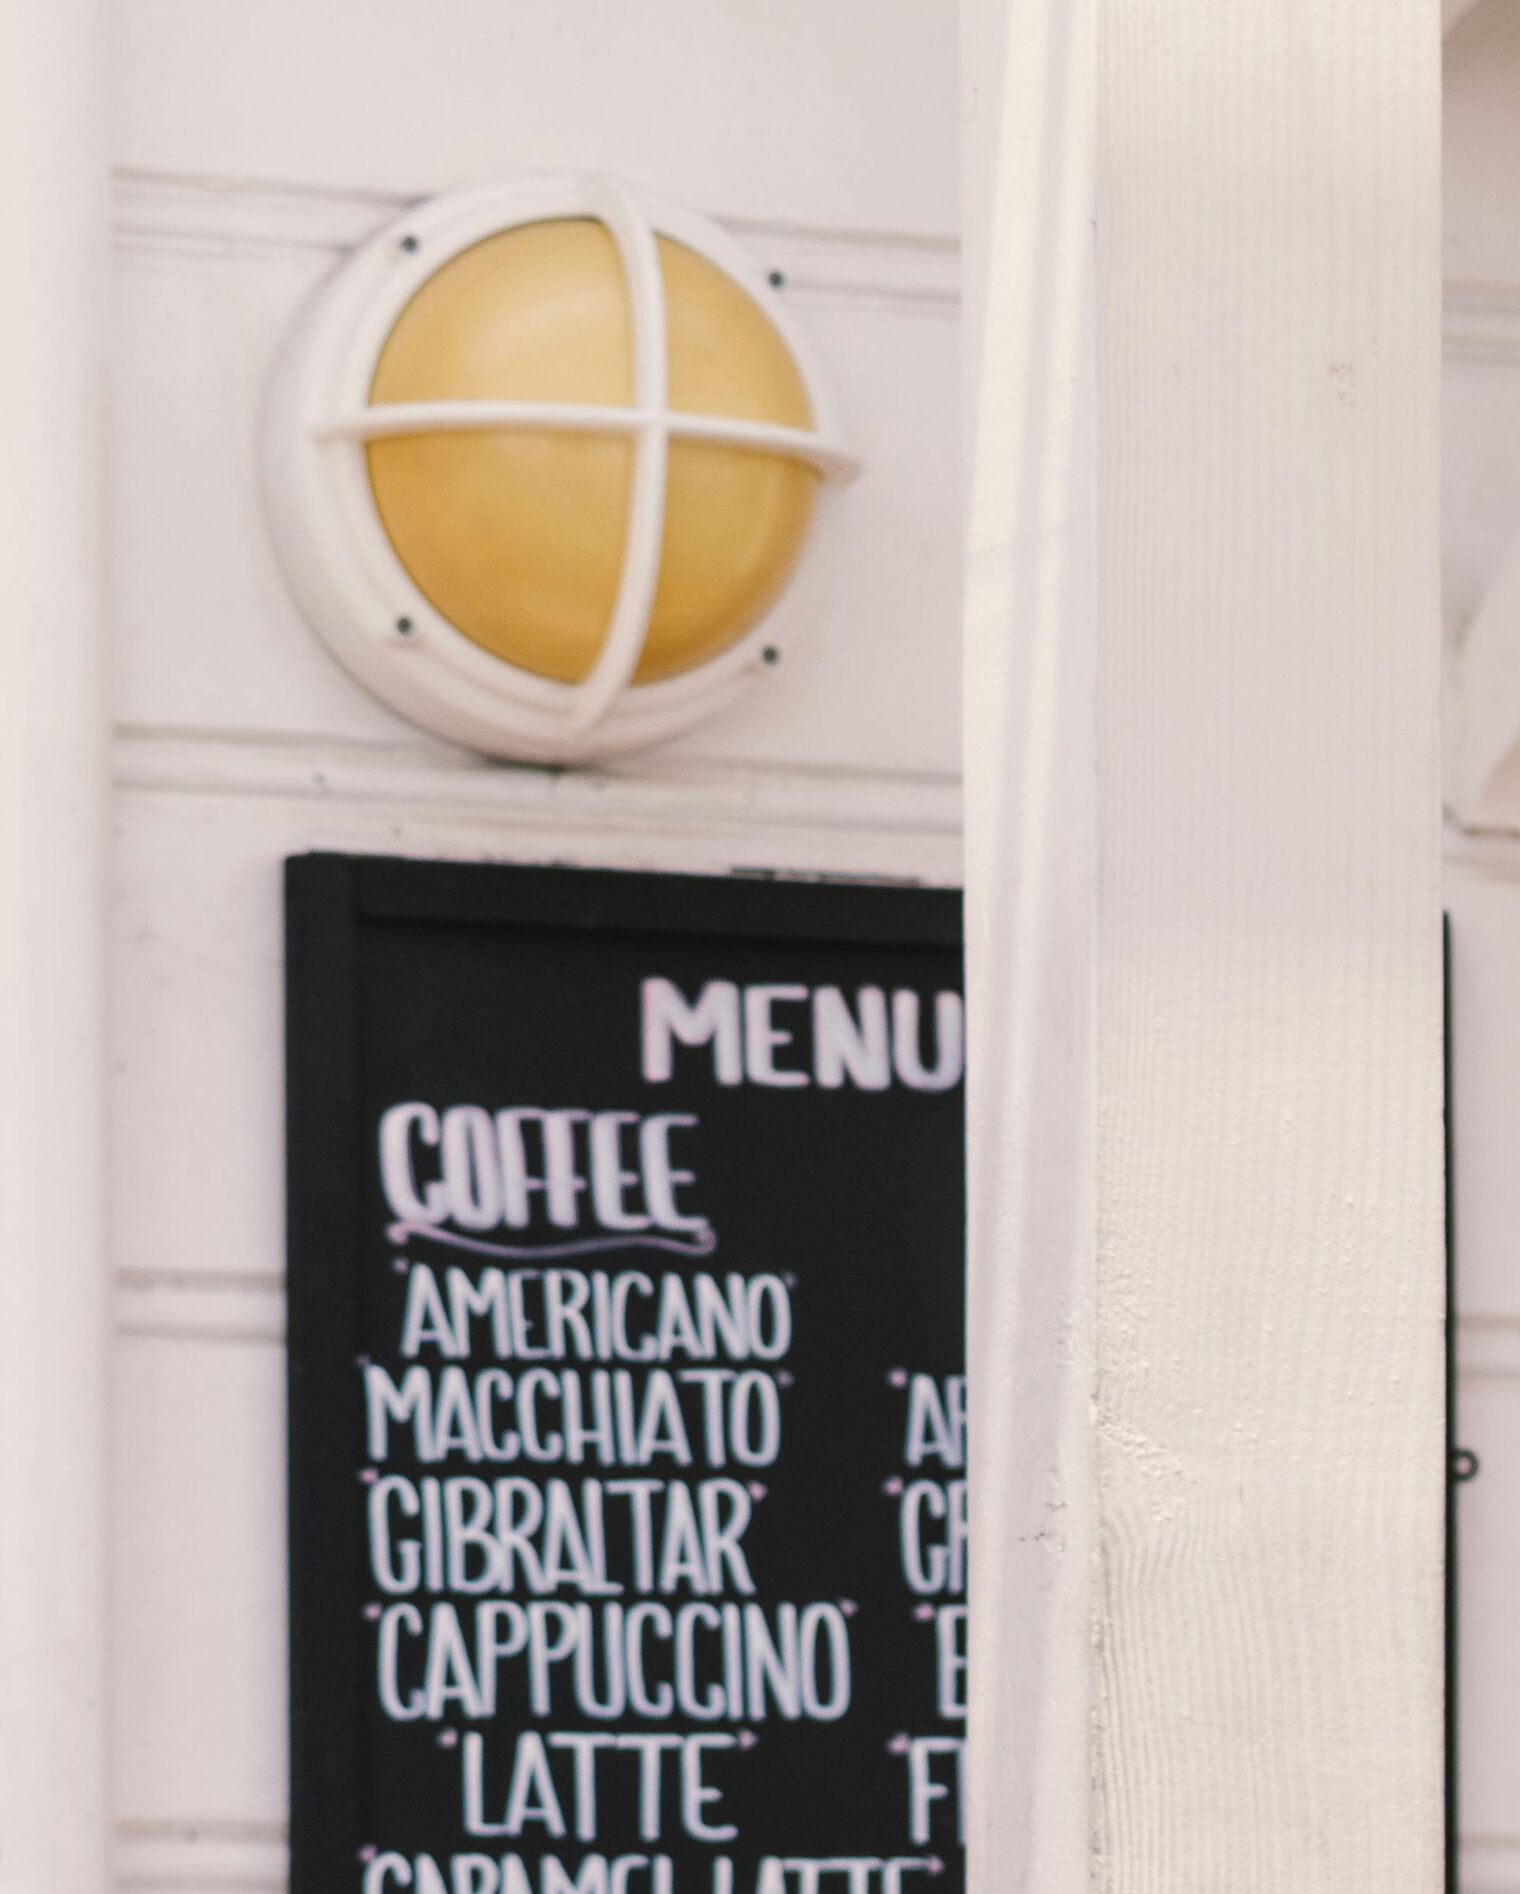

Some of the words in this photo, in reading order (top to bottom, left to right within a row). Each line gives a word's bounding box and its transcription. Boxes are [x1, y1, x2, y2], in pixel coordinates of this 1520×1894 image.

[641, 977, 965, 1091] MENU
[379, 1102, 709, 1231] COFFEE
[400, 1263, 793, 1362] AMERICANO
[363, 1364, 781, 1468] MACCHIATO
[367, 1475, 757, 1595] GIBRALTAR
[377, 1600, 852, 1721] CAPPUCCINO
[462, 1730, 738, 1842] LATTE
